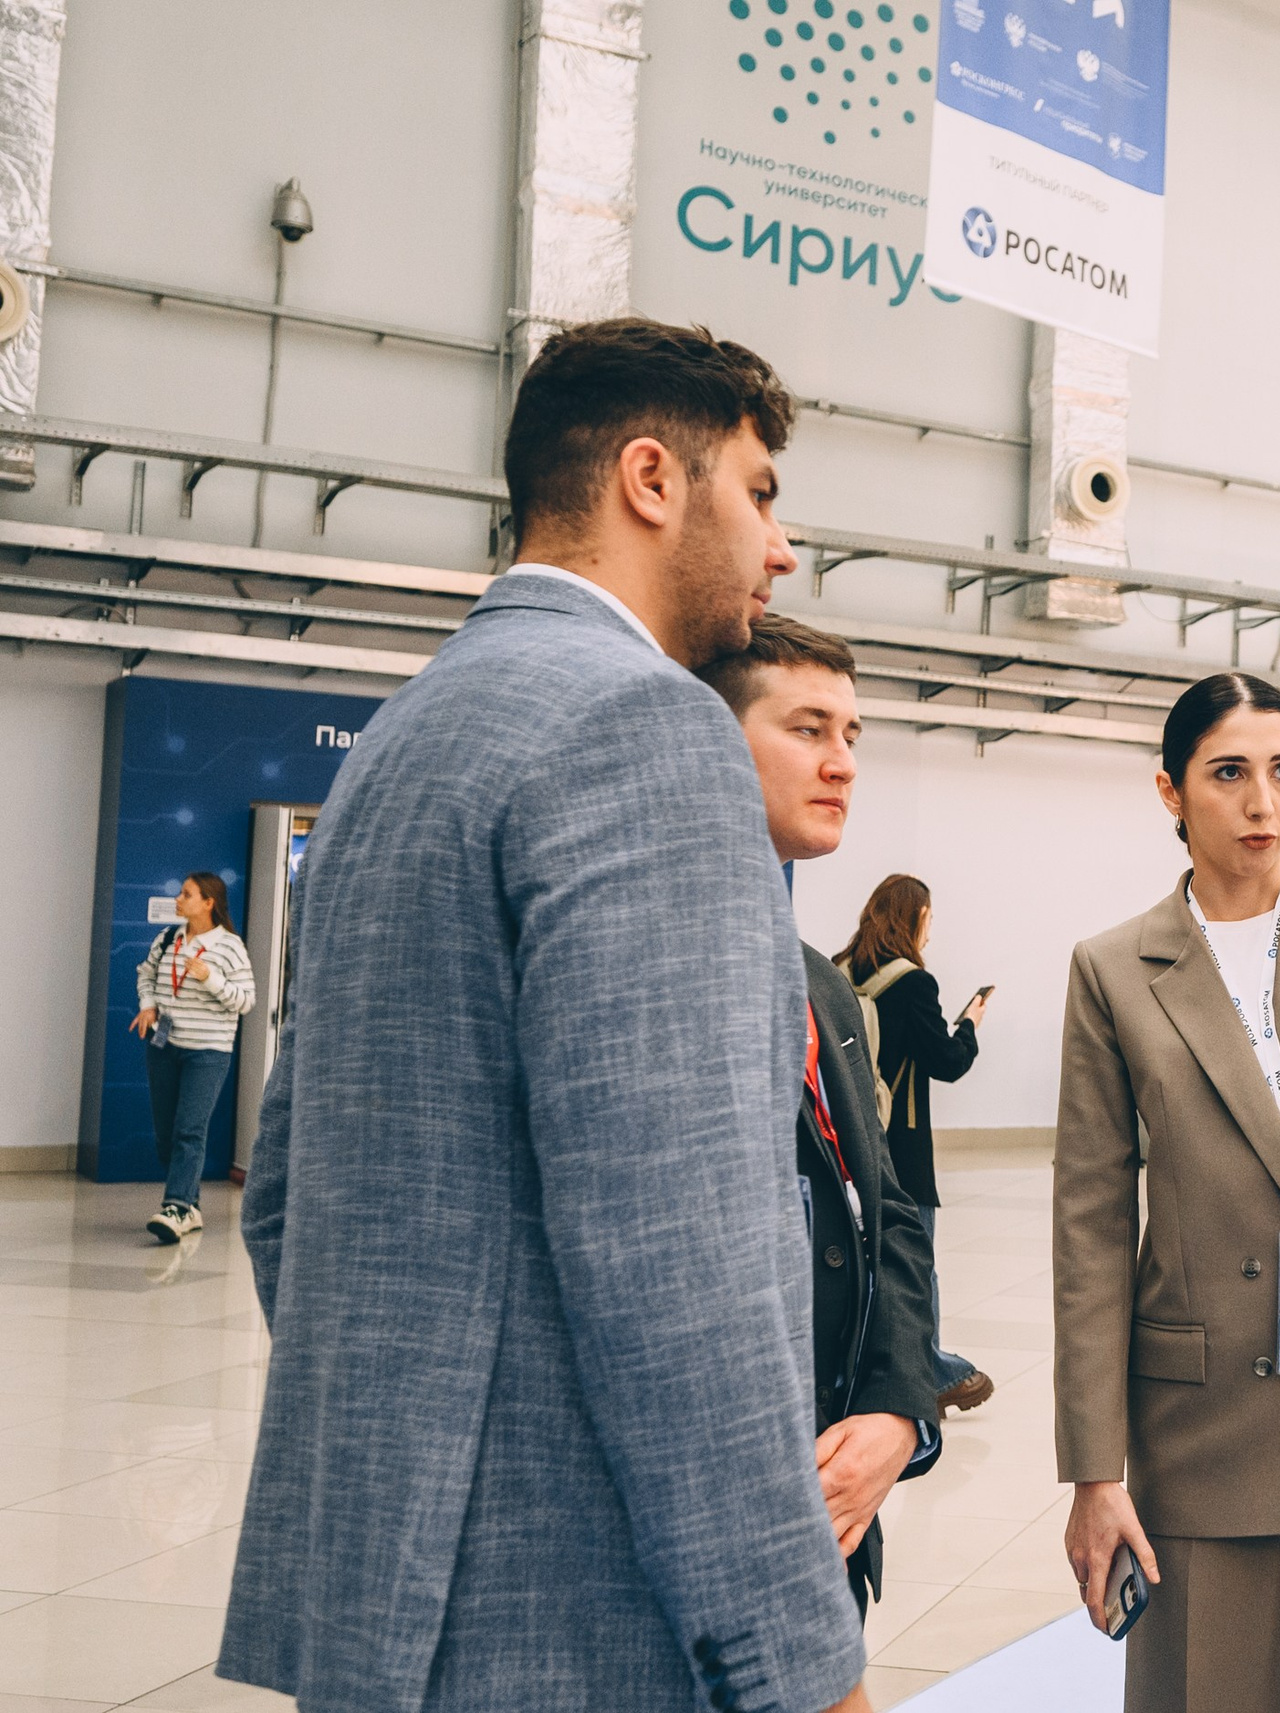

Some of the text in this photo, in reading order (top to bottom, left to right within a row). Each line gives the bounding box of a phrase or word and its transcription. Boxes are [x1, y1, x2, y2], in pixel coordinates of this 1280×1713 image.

[989, 155, 1060, 191] ТИТУЛЬНЫЙ
[763, 180, 888, 218] университет
[677, 185, 963, 307] Сириу
[1005, 230, 1128, 299] РОСАТОМ
[315, 724, 362, 748] Па
